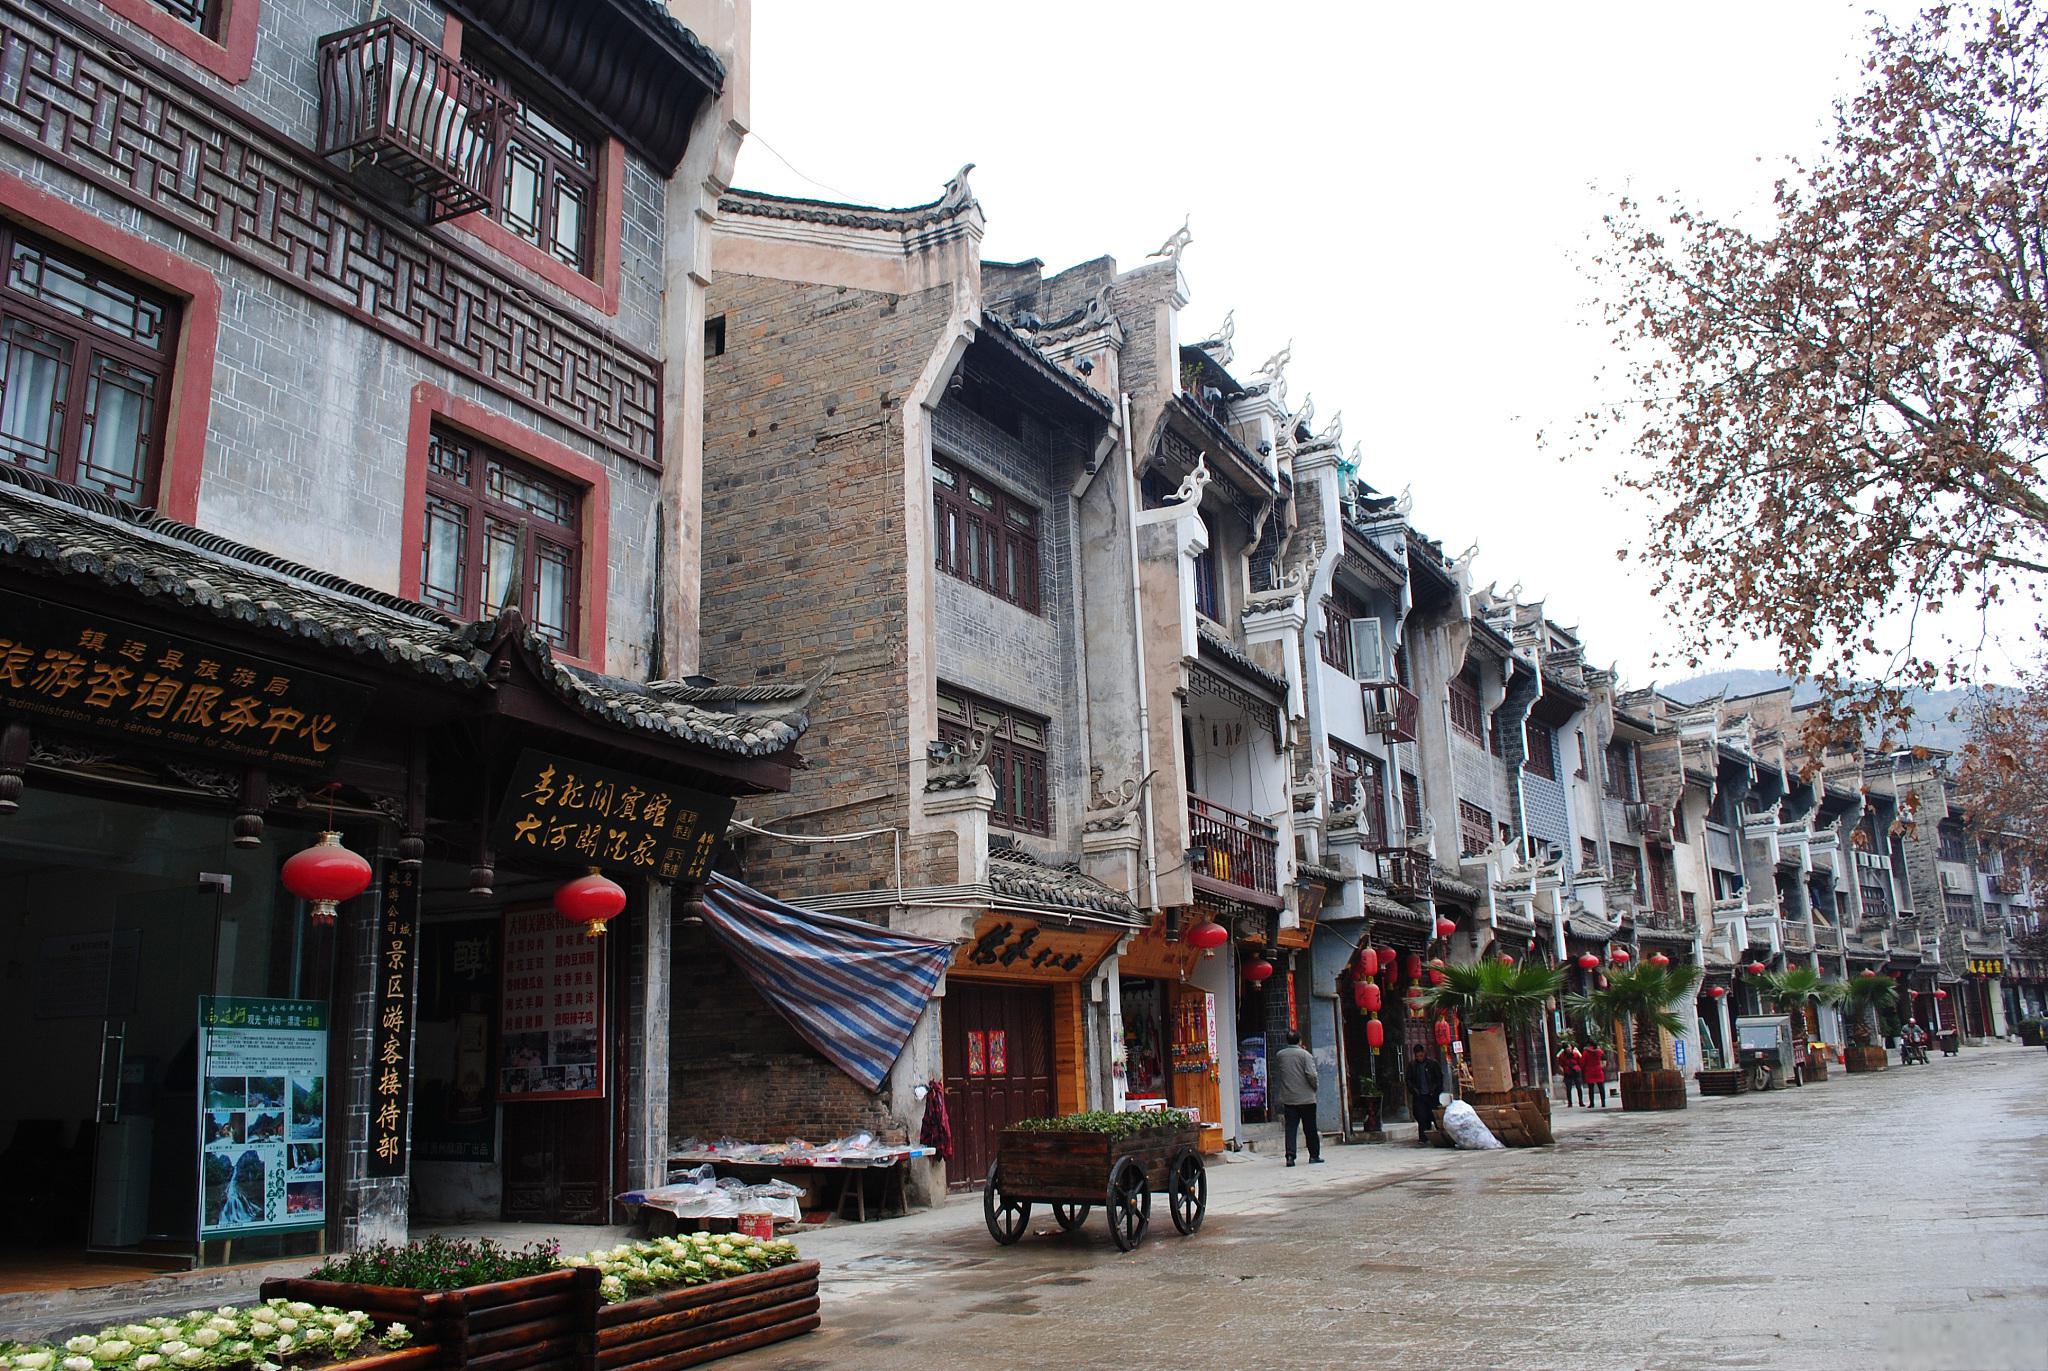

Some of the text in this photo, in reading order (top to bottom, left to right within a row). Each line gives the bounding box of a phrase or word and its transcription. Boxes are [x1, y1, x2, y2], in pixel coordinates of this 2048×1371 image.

[0, 637, 337, 752] 旅游咨询服务中心
[78, 627, 292, 697] 镇远县旅游局
[8, 697, 92, 723] administration
[96, 716, 120, 729] and
[123, 721, 163, 738] service
[166, 730, 201, 745] center
[203, 737, 220, 748] for
[221, 739, 271, 759] Zhenyuan
[272, 750, 328, 769] government
[376, 940, 407, 1165] 景区游客接待部
